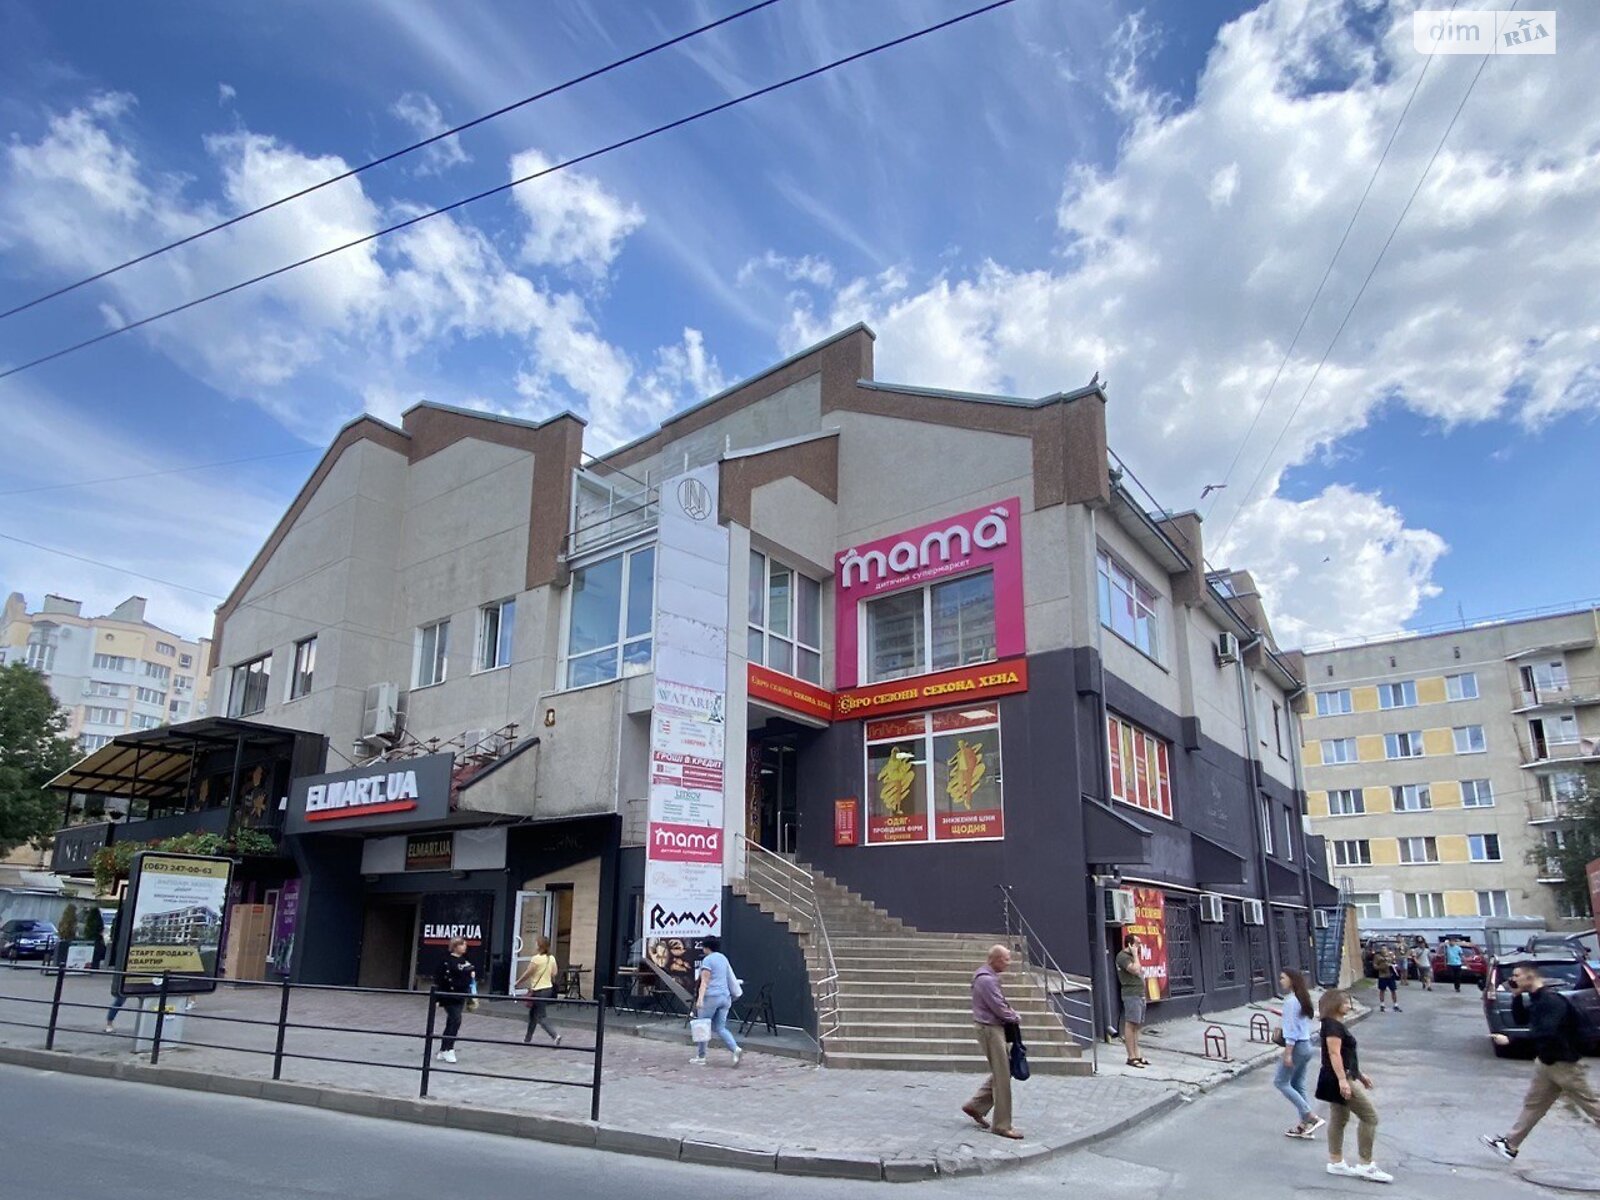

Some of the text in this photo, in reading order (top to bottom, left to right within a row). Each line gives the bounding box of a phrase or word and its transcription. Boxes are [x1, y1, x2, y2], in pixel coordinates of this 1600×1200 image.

[875, 559, 970, 590] дитячий супермаркет
[923, 679, 975, 697] СЕКОНД
[979, 671, 1019, 688] ХЕНД
[305, 770, 419, 812] ELMART.UA
[951, 824, 986, 835] ЩОДНЯ
[407, 839, 452, 857] ELMART.UA
[144, 863, 168, 872] (067)
[424, 924, 482, 939] ELMART.UA
[155, 950, 195, 958] ПРОДАЖУ
